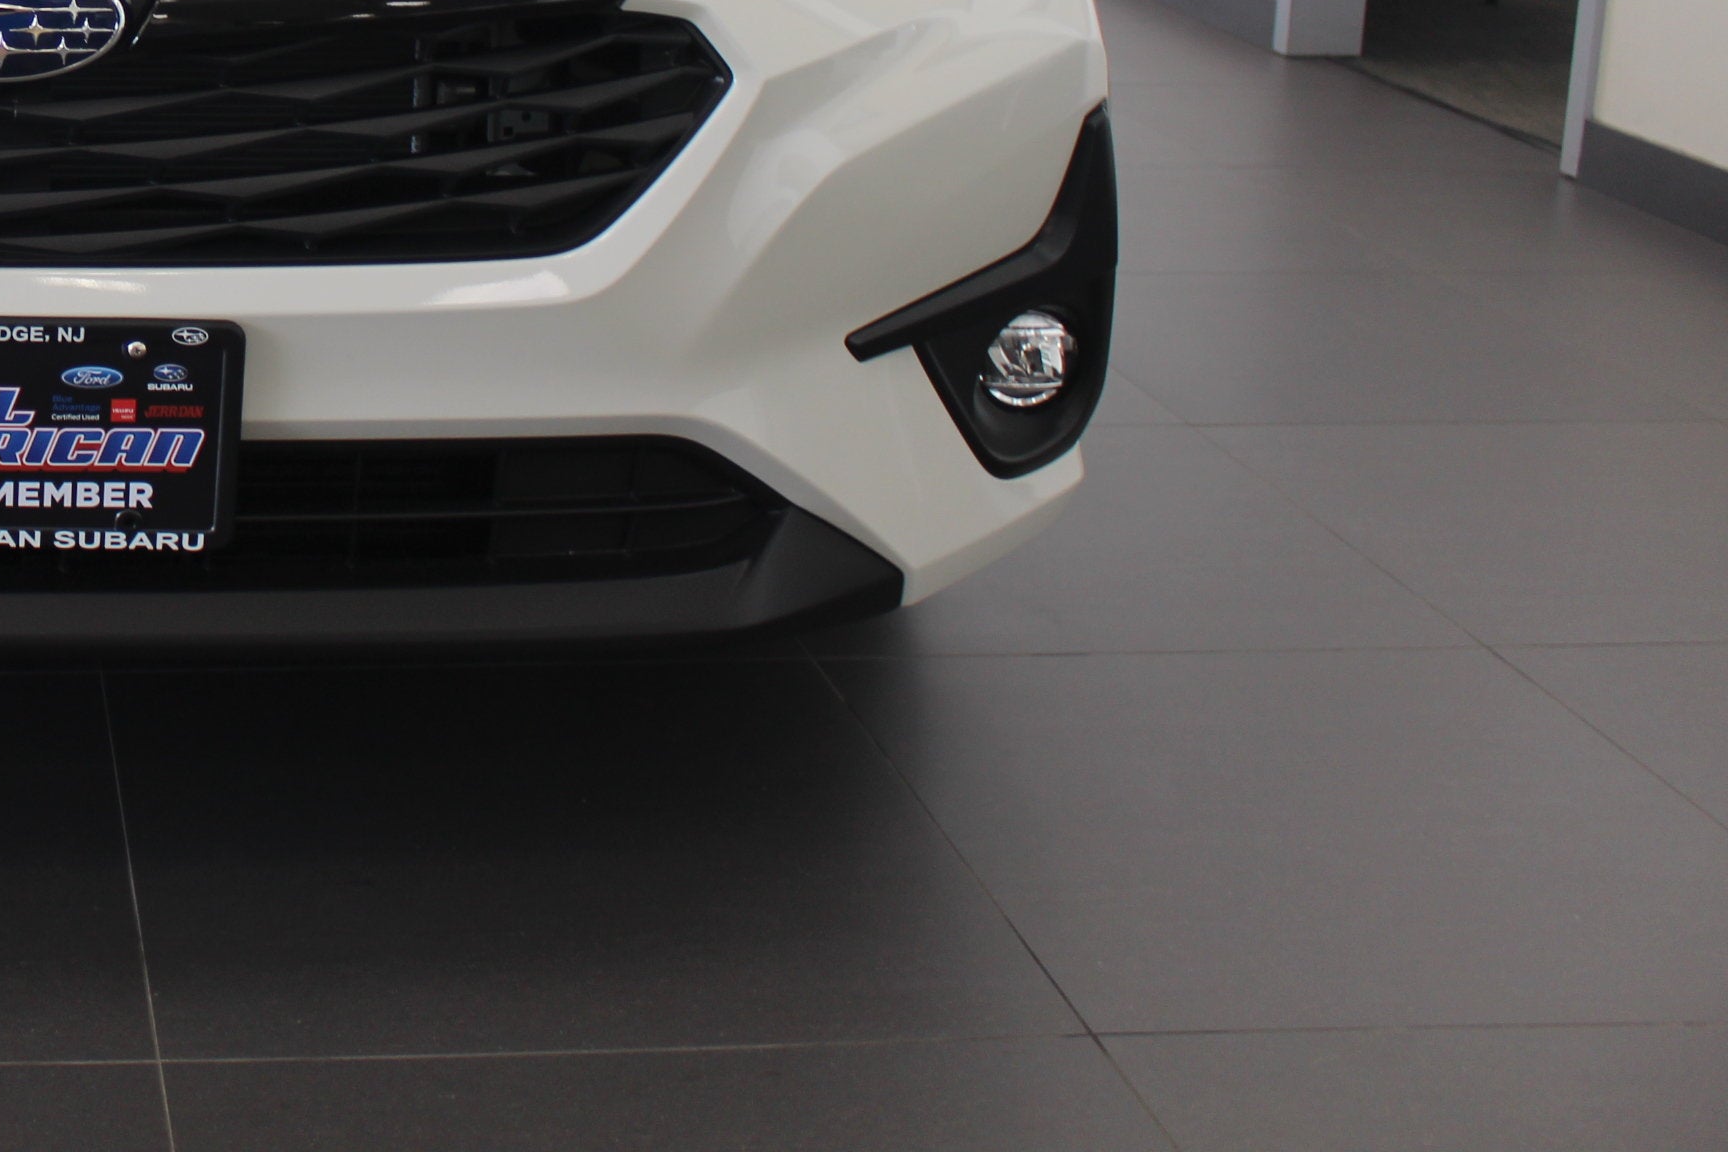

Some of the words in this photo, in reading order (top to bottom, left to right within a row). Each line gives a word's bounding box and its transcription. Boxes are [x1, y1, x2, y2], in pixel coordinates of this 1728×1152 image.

[57, 327, 85, 343] NJ
[72, 369, 112, 385] Ford
[147, 383, 193, 391] SUBARU
[51, 413, 80, 421] Certified
[81, 413, 100, 421] Used
[54, 531, 204, 551] SUBARU
